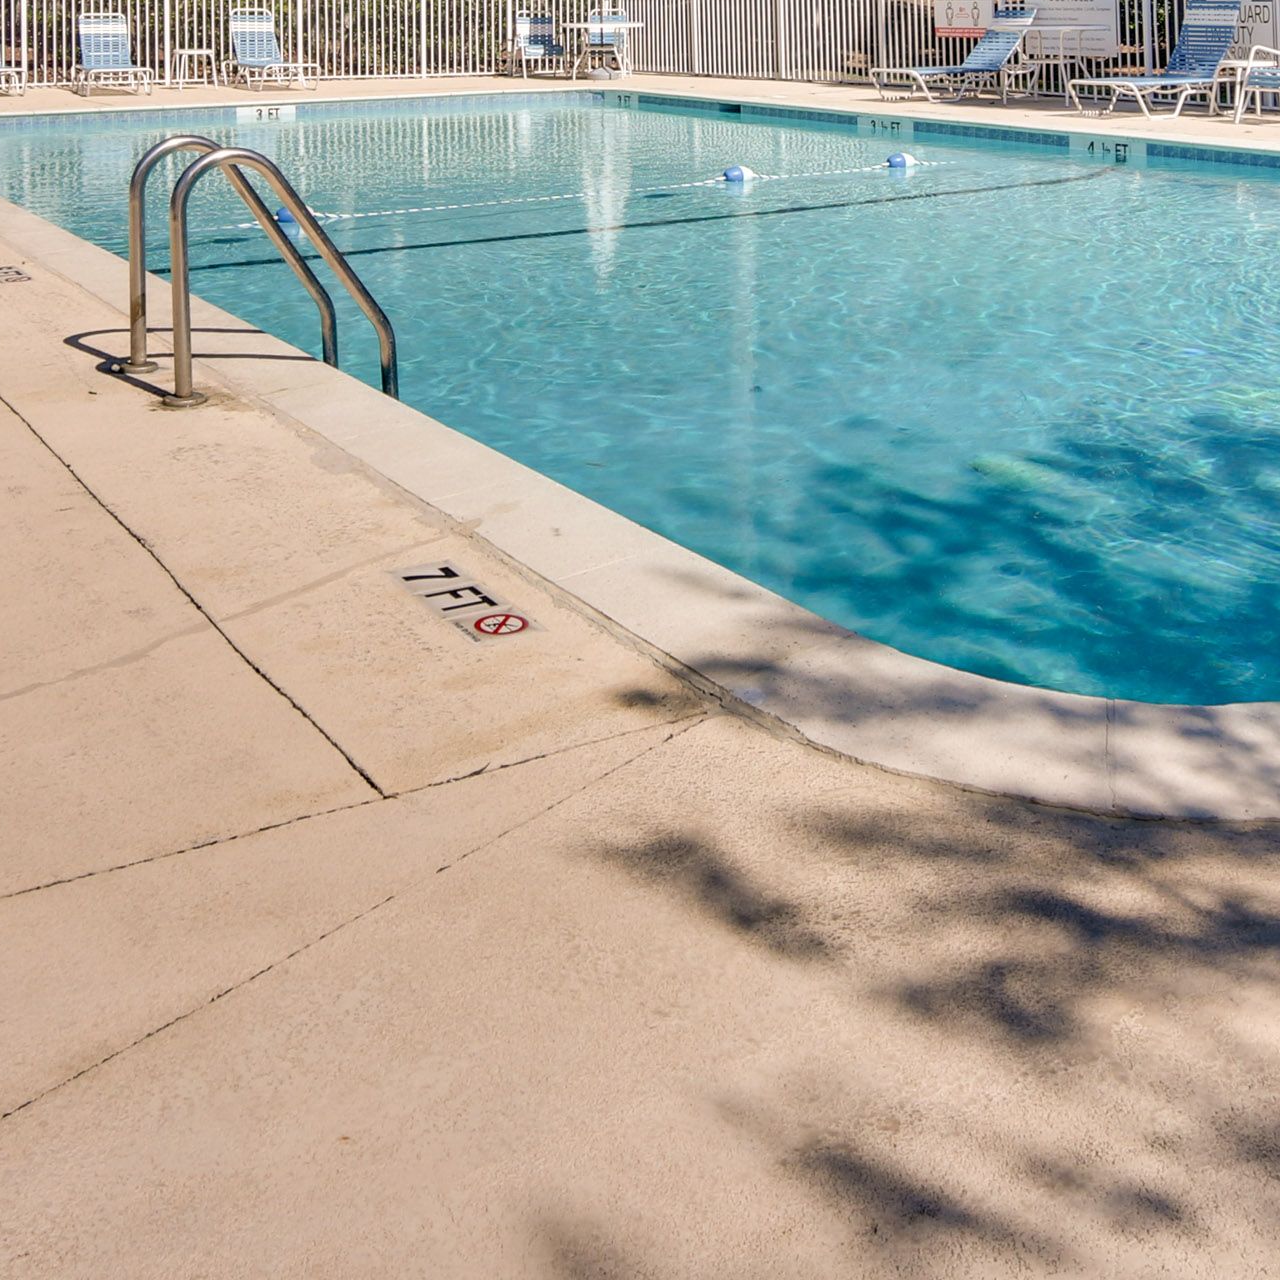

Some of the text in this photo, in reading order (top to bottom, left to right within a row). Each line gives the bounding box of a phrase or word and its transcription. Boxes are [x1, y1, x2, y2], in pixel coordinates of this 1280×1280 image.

[1237, 5, 1270, 24] UARD
[1232, 26, 1254, 45] UTY
[402, 566, 498, 612] 7 FT
